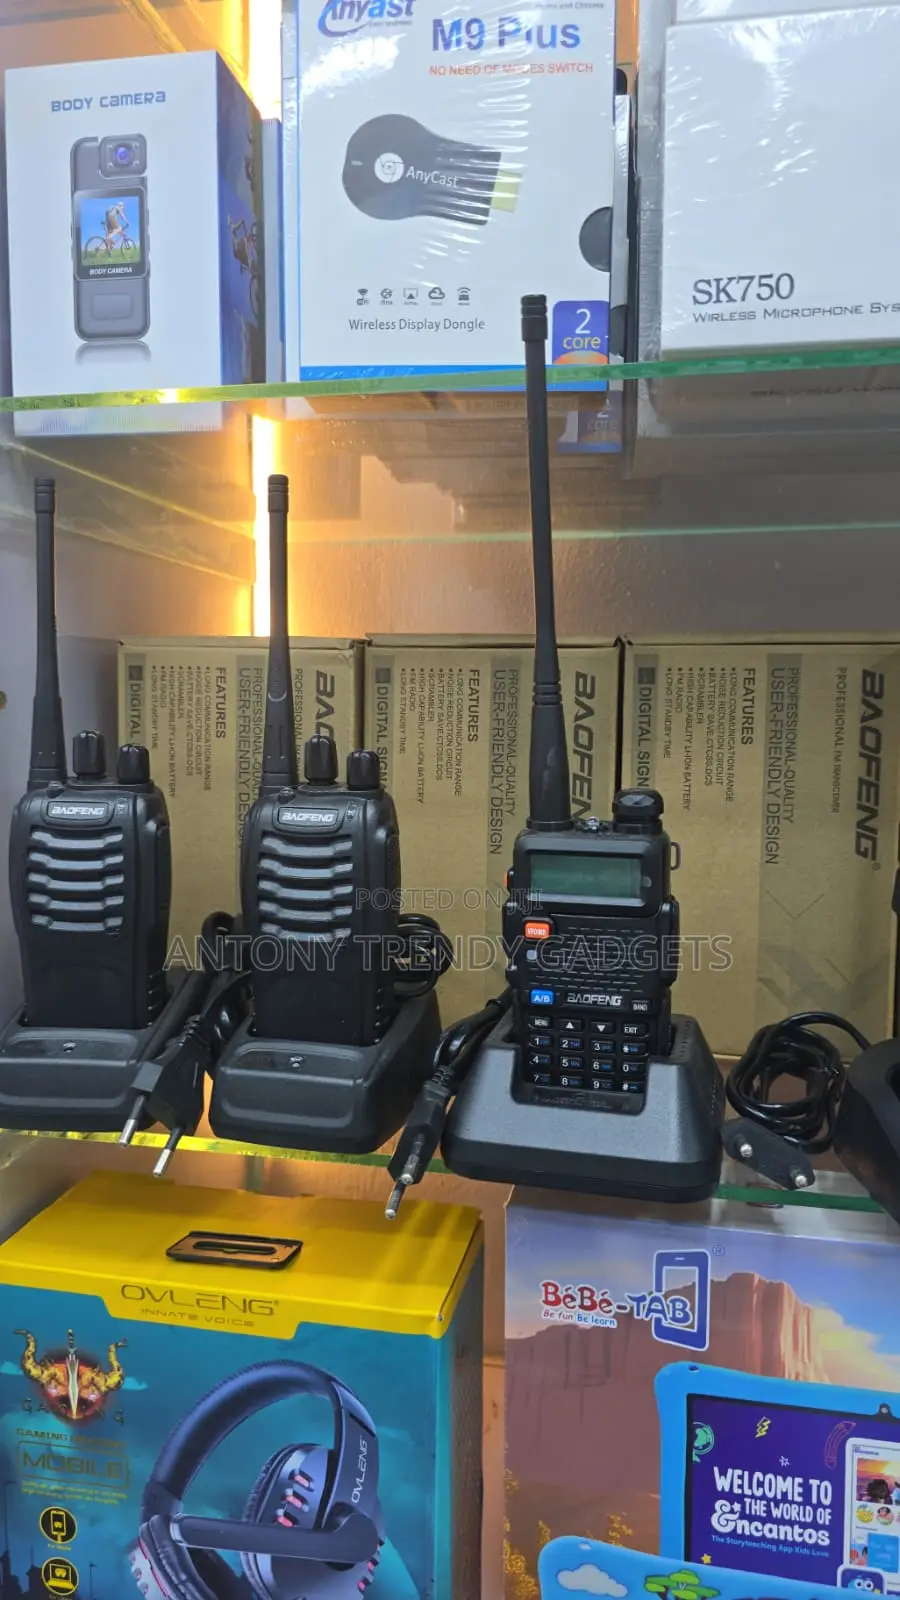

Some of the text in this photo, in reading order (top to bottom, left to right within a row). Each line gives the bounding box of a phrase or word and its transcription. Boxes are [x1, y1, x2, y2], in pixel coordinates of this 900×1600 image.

[432, 16, 581, 51] M9 Plus
[429, 65, 445, 76] NO
[450, 64, 481, 76] NEED
[485, 63, 498, 74] OF
[548, 62, 594, 74] SWITCH
[51, 97, 93, 112] BODY
[406, 166, 457, 188] AnyCast
[692, 273, 795, 305] SK750
[349, 318, 485, 332] Wireless Display Dongle
[576, 308, 591, 334] 2
[562, 335, 601, 350] core
[677, 672, 684, 684] FM
[708, 673, 716, 711] BATTERY
[130, 684, 141, 739] DIGITAL
[216, 667, 226, 739] FEATURES
[468, 670, 480, 742] FEATURES
[697, 673, 705, 724] SCRAMBLER
[741, 668, 756, 745] FEATURES
[834, 667, 847, 748] PROFESSIONAL
[239, 668, 251, 788] USER-FRIENDLY
[377, 687, 388, 742] DIGITAL
[639, 687, 652, 747] DIGITAL
[686, 696, 694, 743] CAPABILITY
[718, 701, 726, 749] REDUCTION
[455, 698, 463, 766] COMMUNICATION
[506, 670, 519, 816] PROFESSIONAL-QUALITY
[727, 699, 736, 770] COMMUNICATION
[783, 668, 800, 823] PROFESSIONAL-QUALITY
[490, 670, 505, 854] USER-FRIENDLY DESIGN
[716, 751, 724, 785] CIRCUIT
[765, 668, 785, 865] USER-FRIENDLY DESIGN
[855, 669, 884, 861] BAOFENG
[683, 772, 692, 810] BATTERY
[726, 772, 734, 803] RANGE
[51, 806, 105, 815] BAOFENG
[282, 812, 335, 822] BAOFENG
[534, 994, 550, 1003] A/B
[567, 993, 623, 1006] BAOFENG
[534, 1038, 540, 1046] 1
[562, 1040, 569, 1048] 2
[624, 1026, 638, 1034] EXIT
[533, 1056, 540, 1064] 4
[594, 1043, 601, 1051] 3
[562, 1059, 569, 1067] 5
[593, 1062, 600, 1070] 6
[623, 1064, 629, 1073] 0
[534, 1074, 540, 1082] 7
[562, 1077, 569, 1086] 8
[594, 1080, 600, 1089] 9
[121, 1284, 274, 1316] OVLENG
[140, 1308, 255, 1327] INNATE VOICE
[543, 1310, 616, 1327] Be fun Be learn
[23, 1450, 122, 1478] MOBILE
[351, 1436, 368, 1503] OVLENG
[713, 1466, 832, 1505] WELCOME TO
[744, 1498, 832, 1525] THE WORLD OF
[712, 1535, 725, 1543] The
[779, 1544, 793, 1553] App
[795, 1546, 810, 1555] Kids
